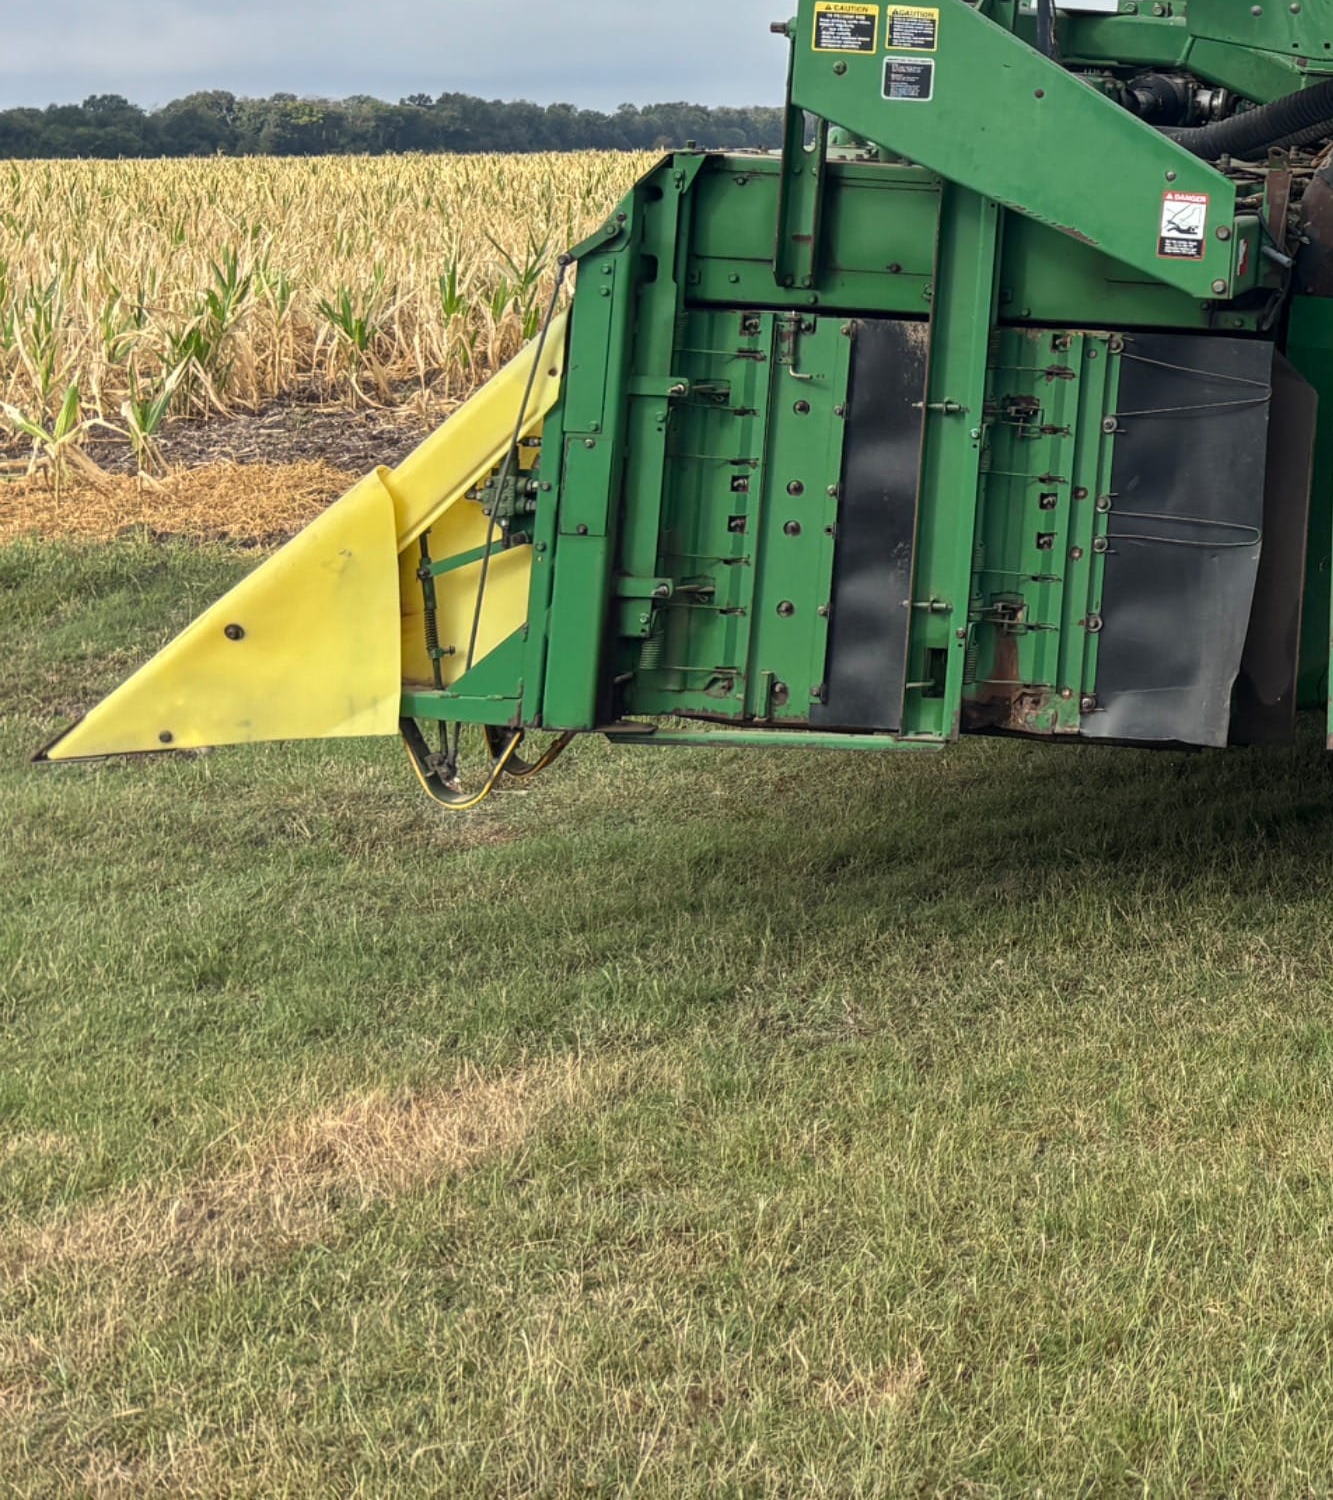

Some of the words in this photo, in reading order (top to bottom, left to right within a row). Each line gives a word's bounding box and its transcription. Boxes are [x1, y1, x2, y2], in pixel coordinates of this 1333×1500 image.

[833, 4, 869, 13] CAUTION
[899, 9, 935, 18] CAUTION
[1174, 194, 1207, 202] DANGER
